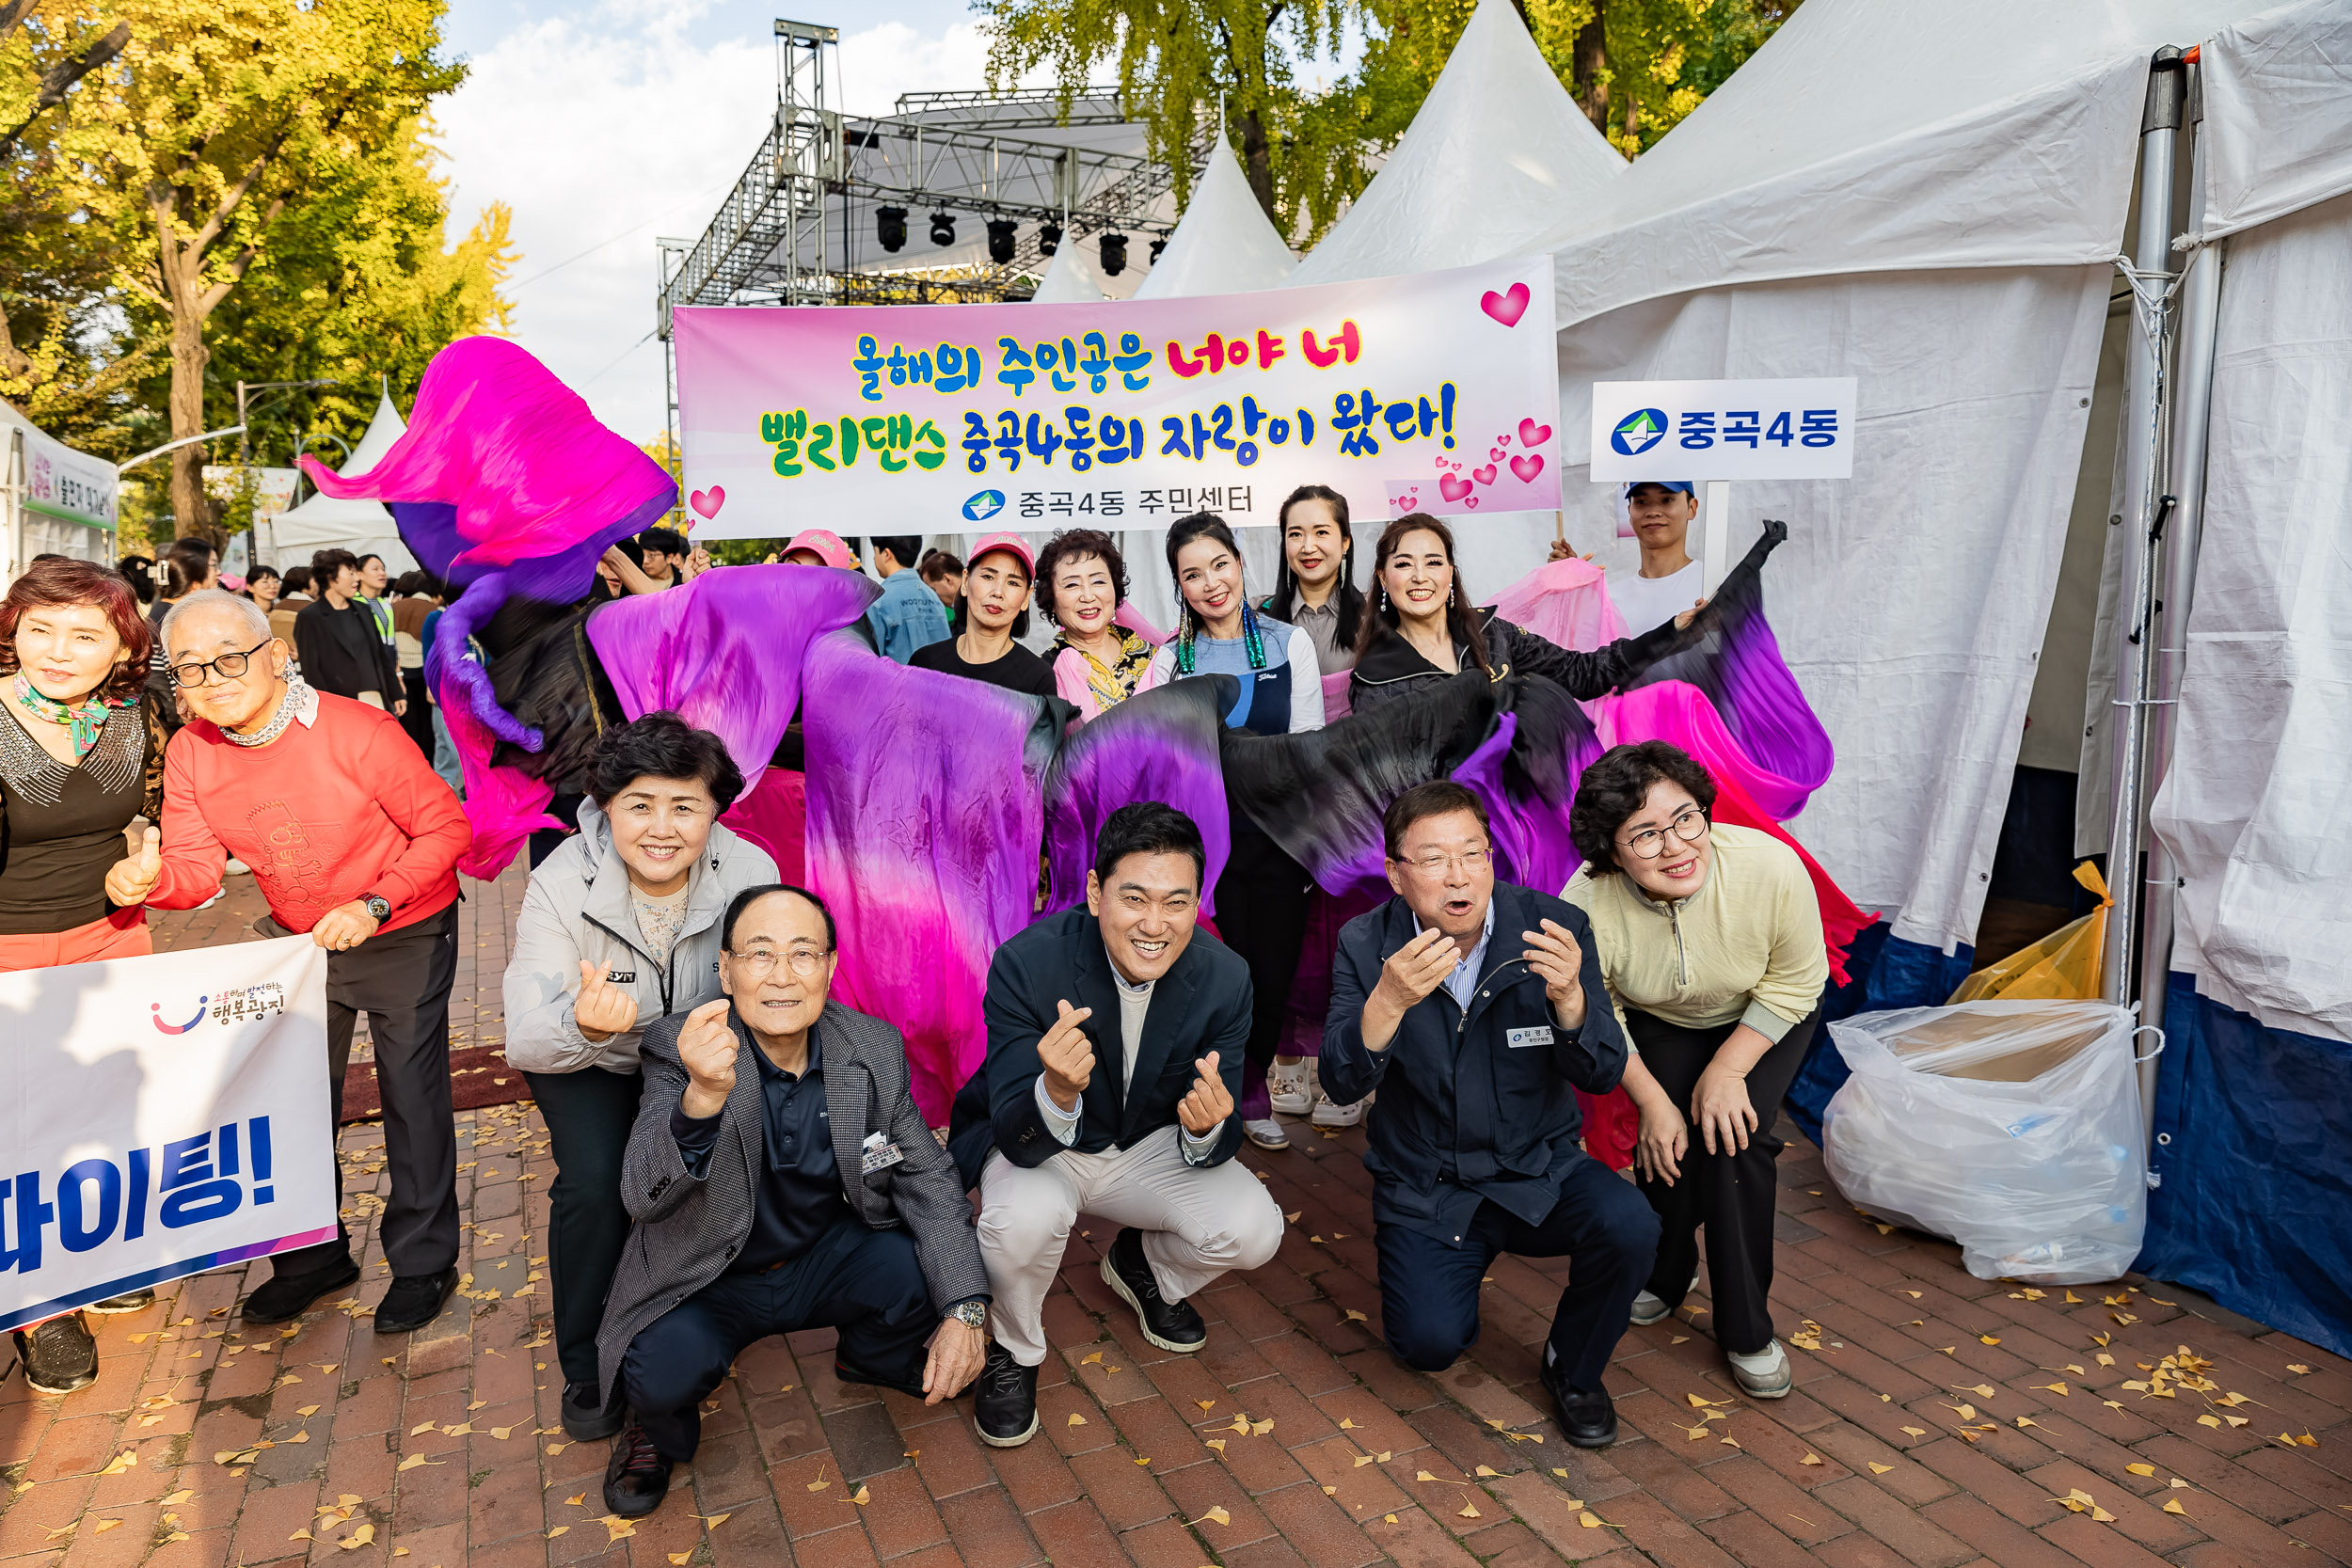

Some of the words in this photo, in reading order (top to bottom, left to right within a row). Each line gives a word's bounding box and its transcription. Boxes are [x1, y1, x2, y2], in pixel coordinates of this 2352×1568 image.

[851, 334, 983, 402] 올해의
[997, 331, 1153, 396] 주인공은
[1167, 328, 1286, 378] 너야
[1301, 320, 1361, 369] 너
[760, 408, 946, 477] 밸리댄스
[961, 405, 1144, 473] 중곡4동의
[1159, 394, 1316, 467] 자랑이
[1329, 381, 1457, 457] 왔다!
[1678, 409, 1838, 450] 중곡4동
[1019, 489, 1125, 517] 중곡4동
[1138, 485, 1252, 515] 주민센터
[212, 994, 284, 1025] 행복광진
[214, 989, 246, 1005] 소통하며
[247, 982, 283, 999] 발전하는
[0, 1116, 274, 1275] 파이팅!
